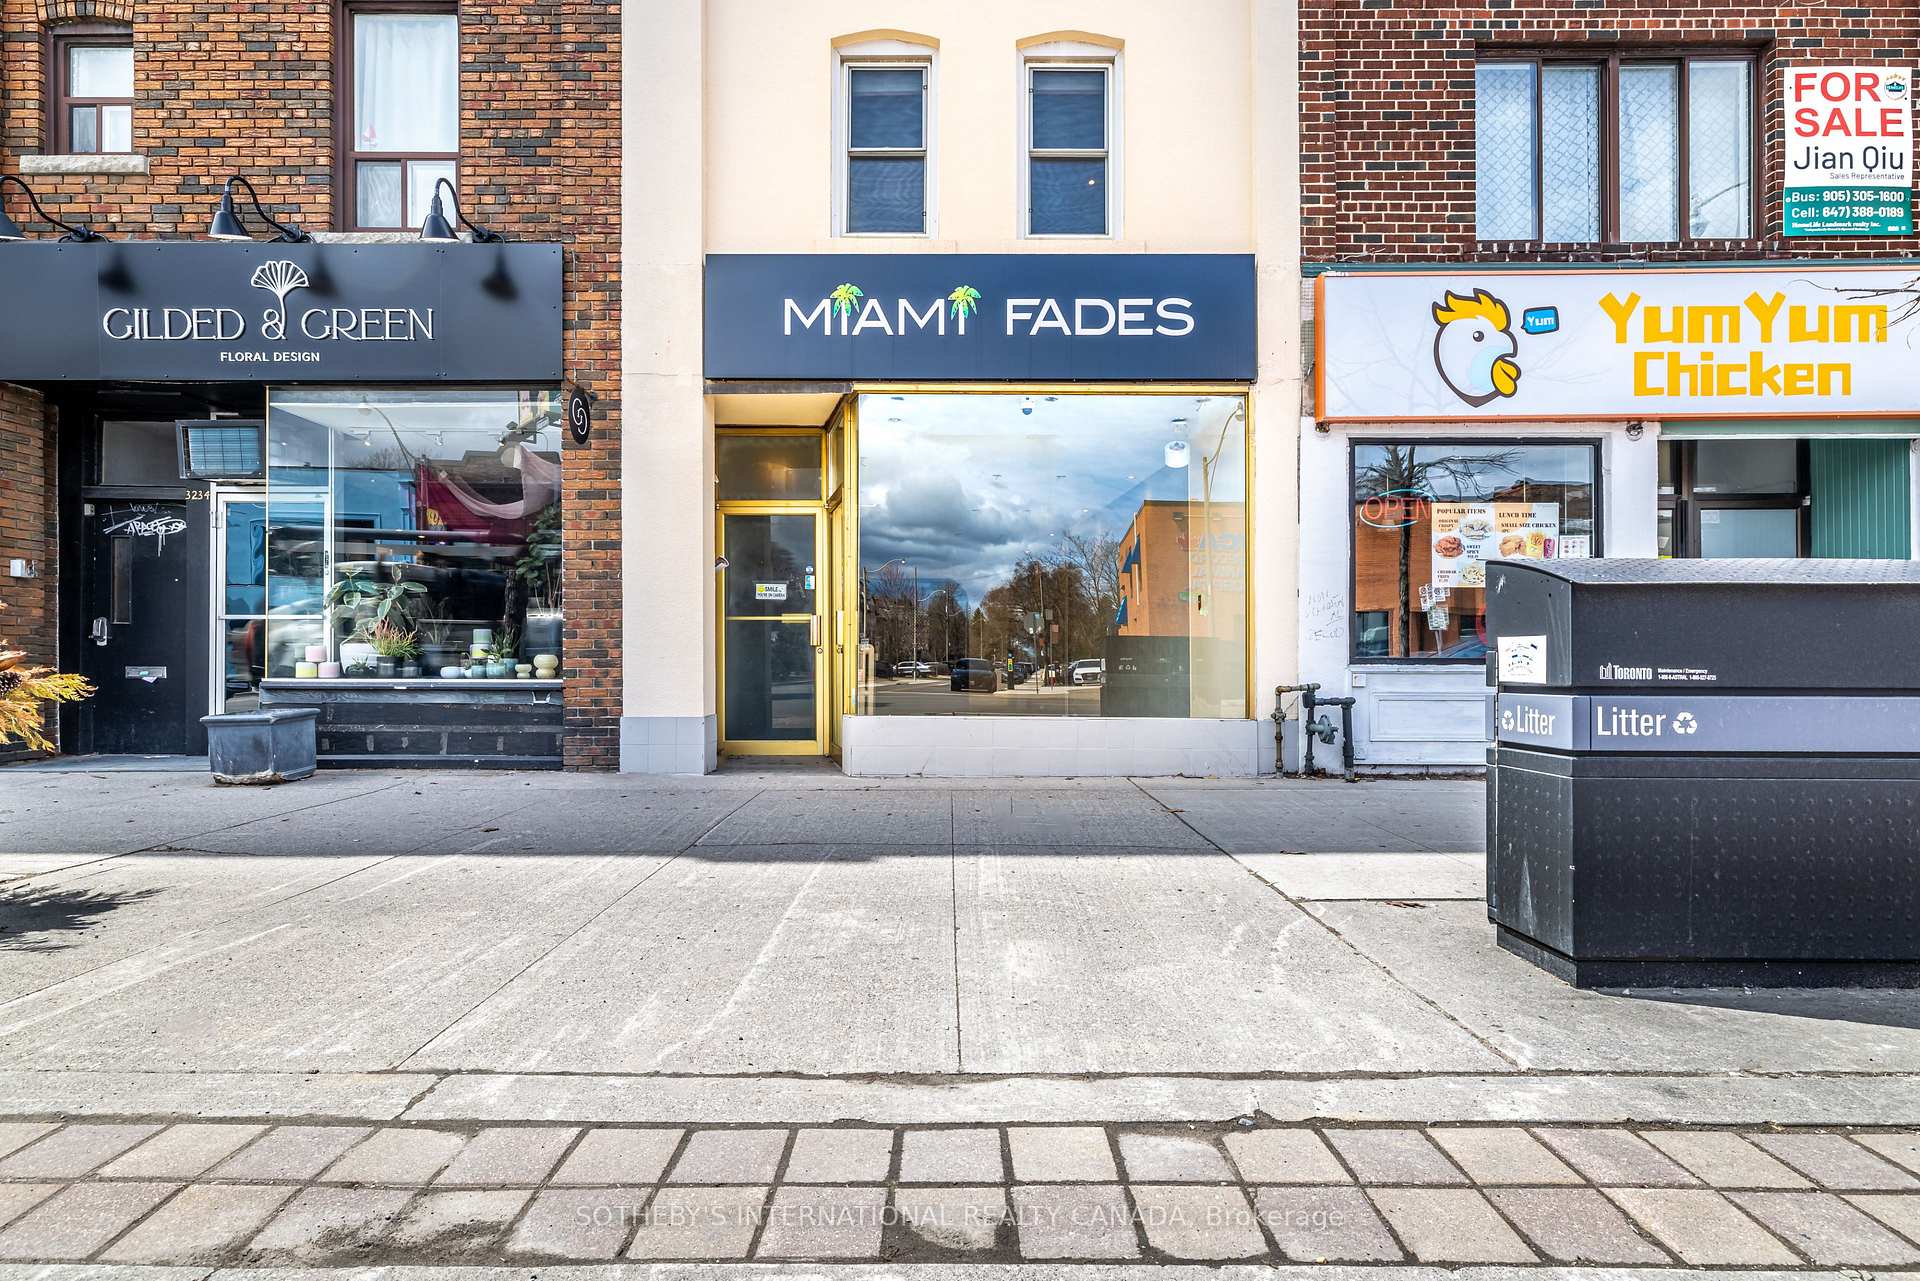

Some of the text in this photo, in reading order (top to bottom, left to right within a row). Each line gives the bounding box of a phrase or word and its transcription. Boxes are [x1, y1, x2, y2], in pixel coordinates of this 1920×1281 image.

[1794, 72, 1881, 102] FOR
[1794, 108, 1904, 137] SALE
[1794, 146, 1903, 172] Jian Qiu
[1830, 172, 1850, 180] Sales
[1791, 190, 1905, 202] Bus: 905) 305-1600
[1791, 206, 1904, 218] Cell: 647) 388-0189
[102, 307, 435, 341] GILDED & GREEN
[784, 285, 1196, 337] MIAMI FADES
[1526, 315, 1555, 328] Yum
[1599, 291, 1888, 343] YumYum
[220, 352, 320, 363] FLORAL DESIGN
[1633, 351, 1852, 397] Chicken
[184, 490, 210, 500] 3234
[1364, 496, 1431, 520] OPEN
[1612, 664, 1653, 680] TORONTO
[1516, 704, 1556, 736] Litter
[1597, 706, 1667, 736] Litter
